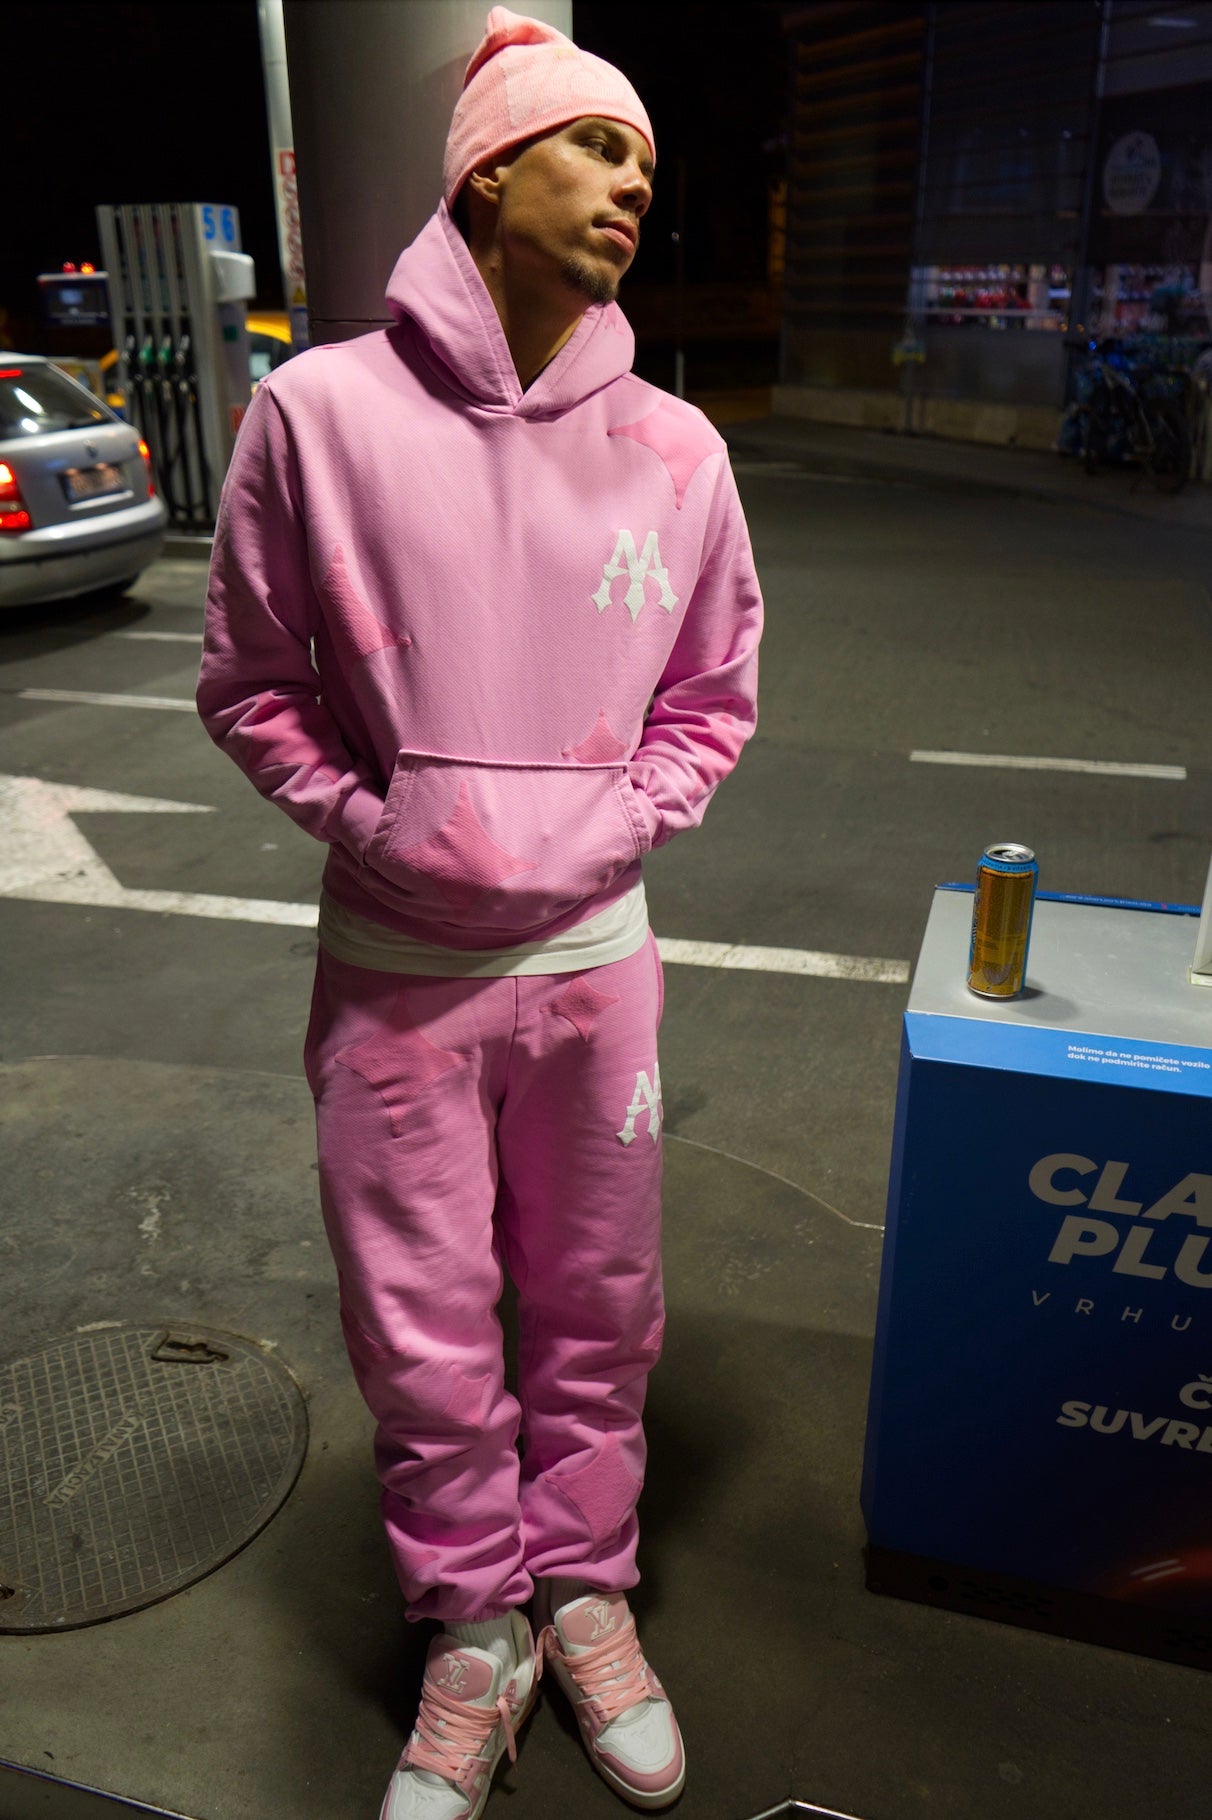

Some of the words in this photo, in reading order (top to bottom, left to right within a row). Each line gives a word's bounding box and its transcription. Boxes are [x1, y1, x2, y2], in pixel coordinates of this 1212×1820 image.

[202, 206, 216, 241] 5
[220, 207, 235, 243] 6
[1067, 1045, 1104, 1056] Molimo
[1133, 1053, 1180, 1065] pomičete
[1180, 1059, 1211, 1069] vozilo
[1067, 1052, 1086, 1061] dok
[1101, 1056, 1150, 1069] podmirite
[1151, 1063, 1182, 1073] račun.
[1028, 1153, 1212, 1228] CLA
